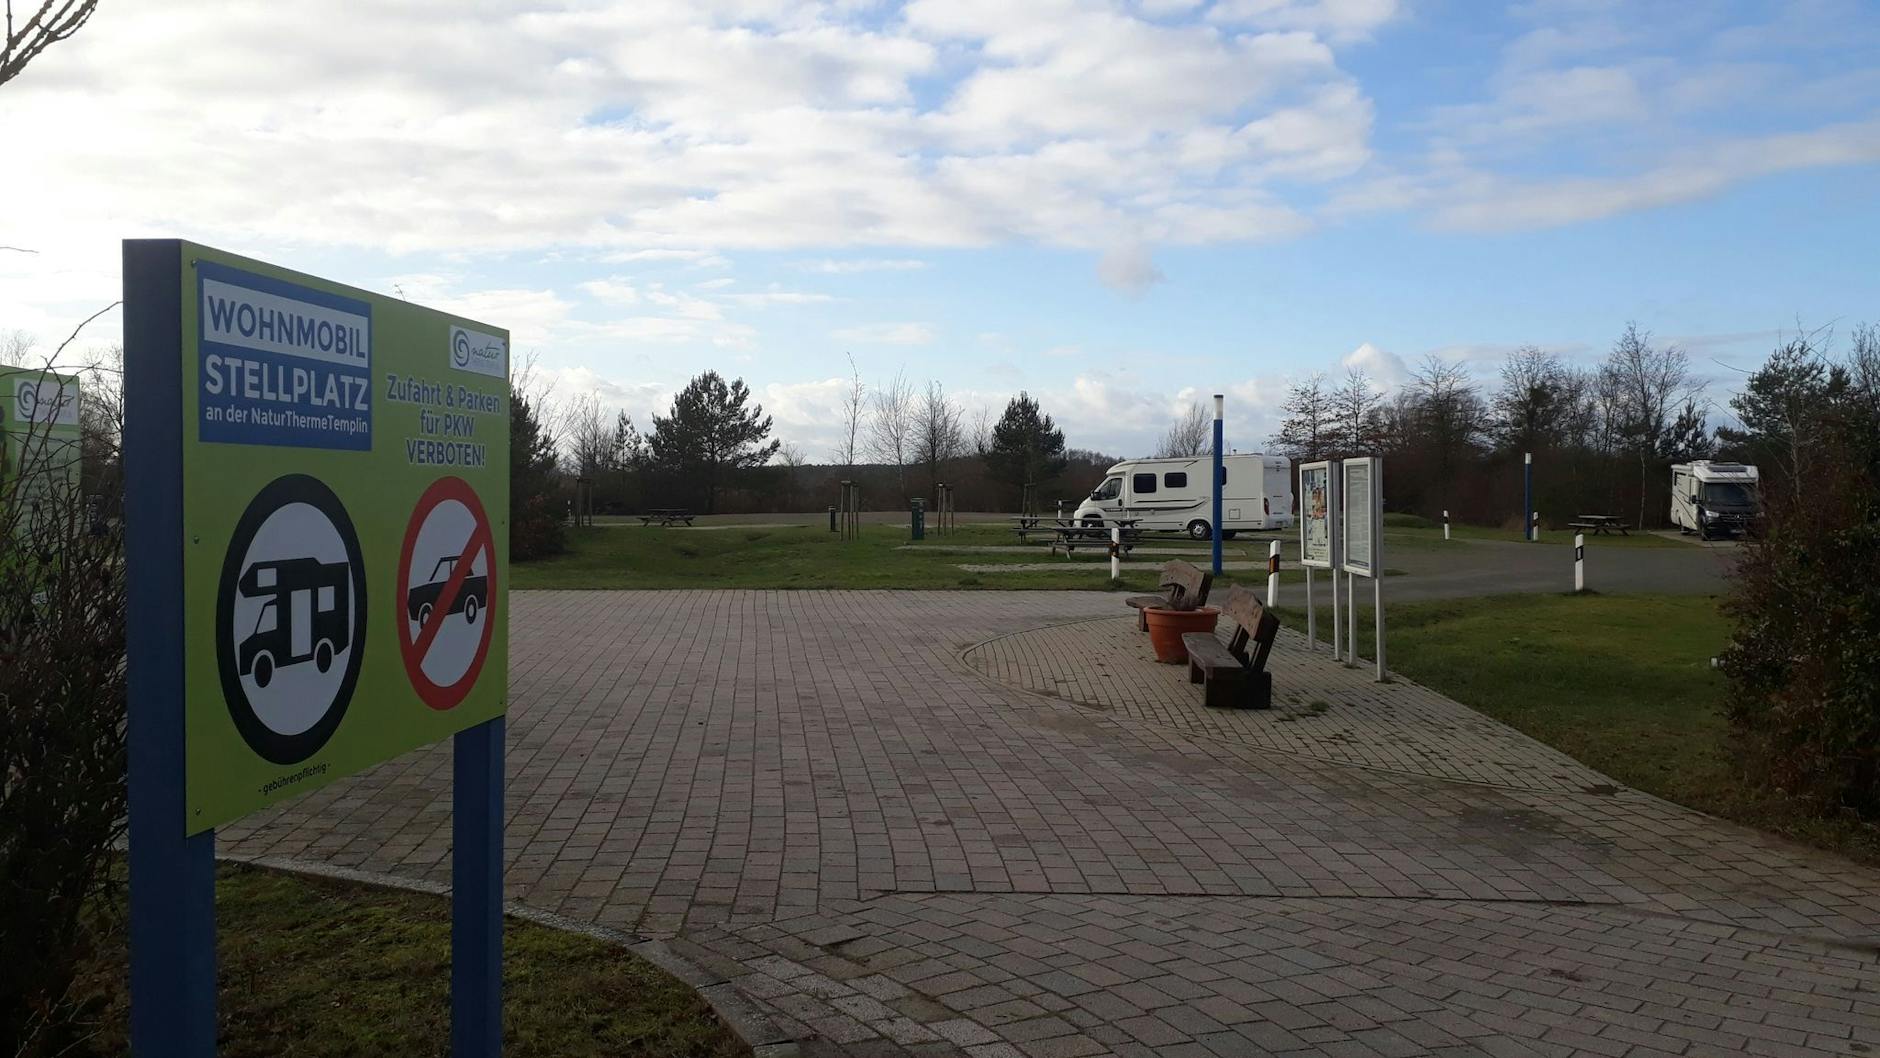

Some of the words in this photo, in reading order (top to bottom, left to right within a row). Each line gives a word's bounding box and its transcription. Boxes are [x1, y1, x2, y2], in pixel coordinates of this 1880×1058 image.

[208, 295, 366, 359] WOHNMOBIL
[205, 354, 368, 411] STELLPLATZ
[387, 375, 441, 406] Zufahrt
[446, 385, 454, 407] &
[458, 386, 500, 413] Parken
[206, 406, 222, 421] an
[226, 405, 248, 423] der
[251, 408, 368, 435] NaturThermeTemplin
[420, 409, 440, 435] für
[444, 413, 474, 437] PKW
[406, 439, 486, 467] VERBOTEN!
